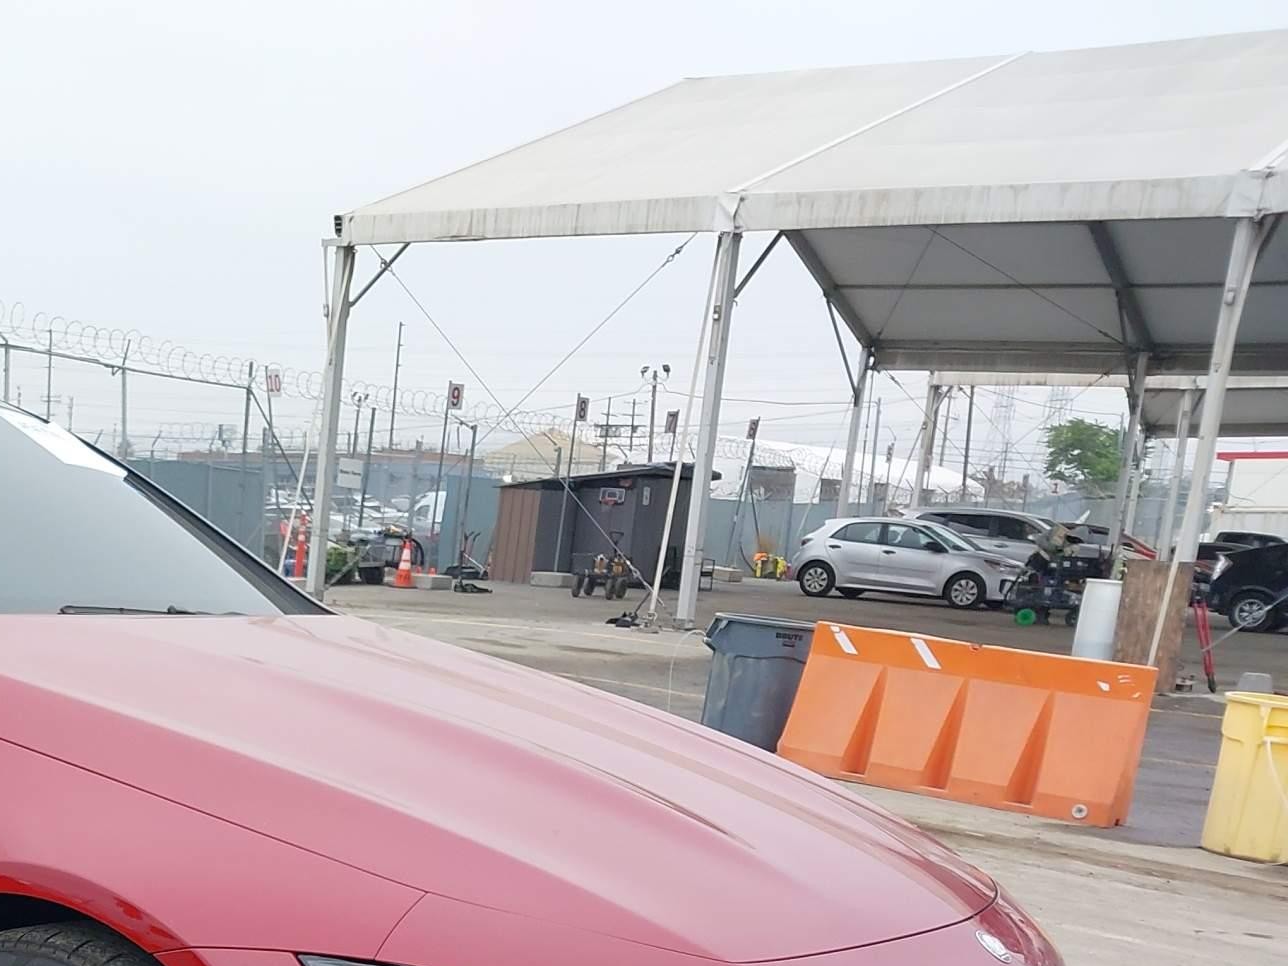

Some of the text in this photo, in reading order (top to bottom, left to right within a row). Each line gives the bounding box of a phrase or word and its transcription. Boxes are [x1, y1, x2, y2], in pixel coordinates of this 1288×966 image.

[268, 374, 281, 392] 10
[451, 386, 461, 406] 9
[578, 400, 587, 419] 8
